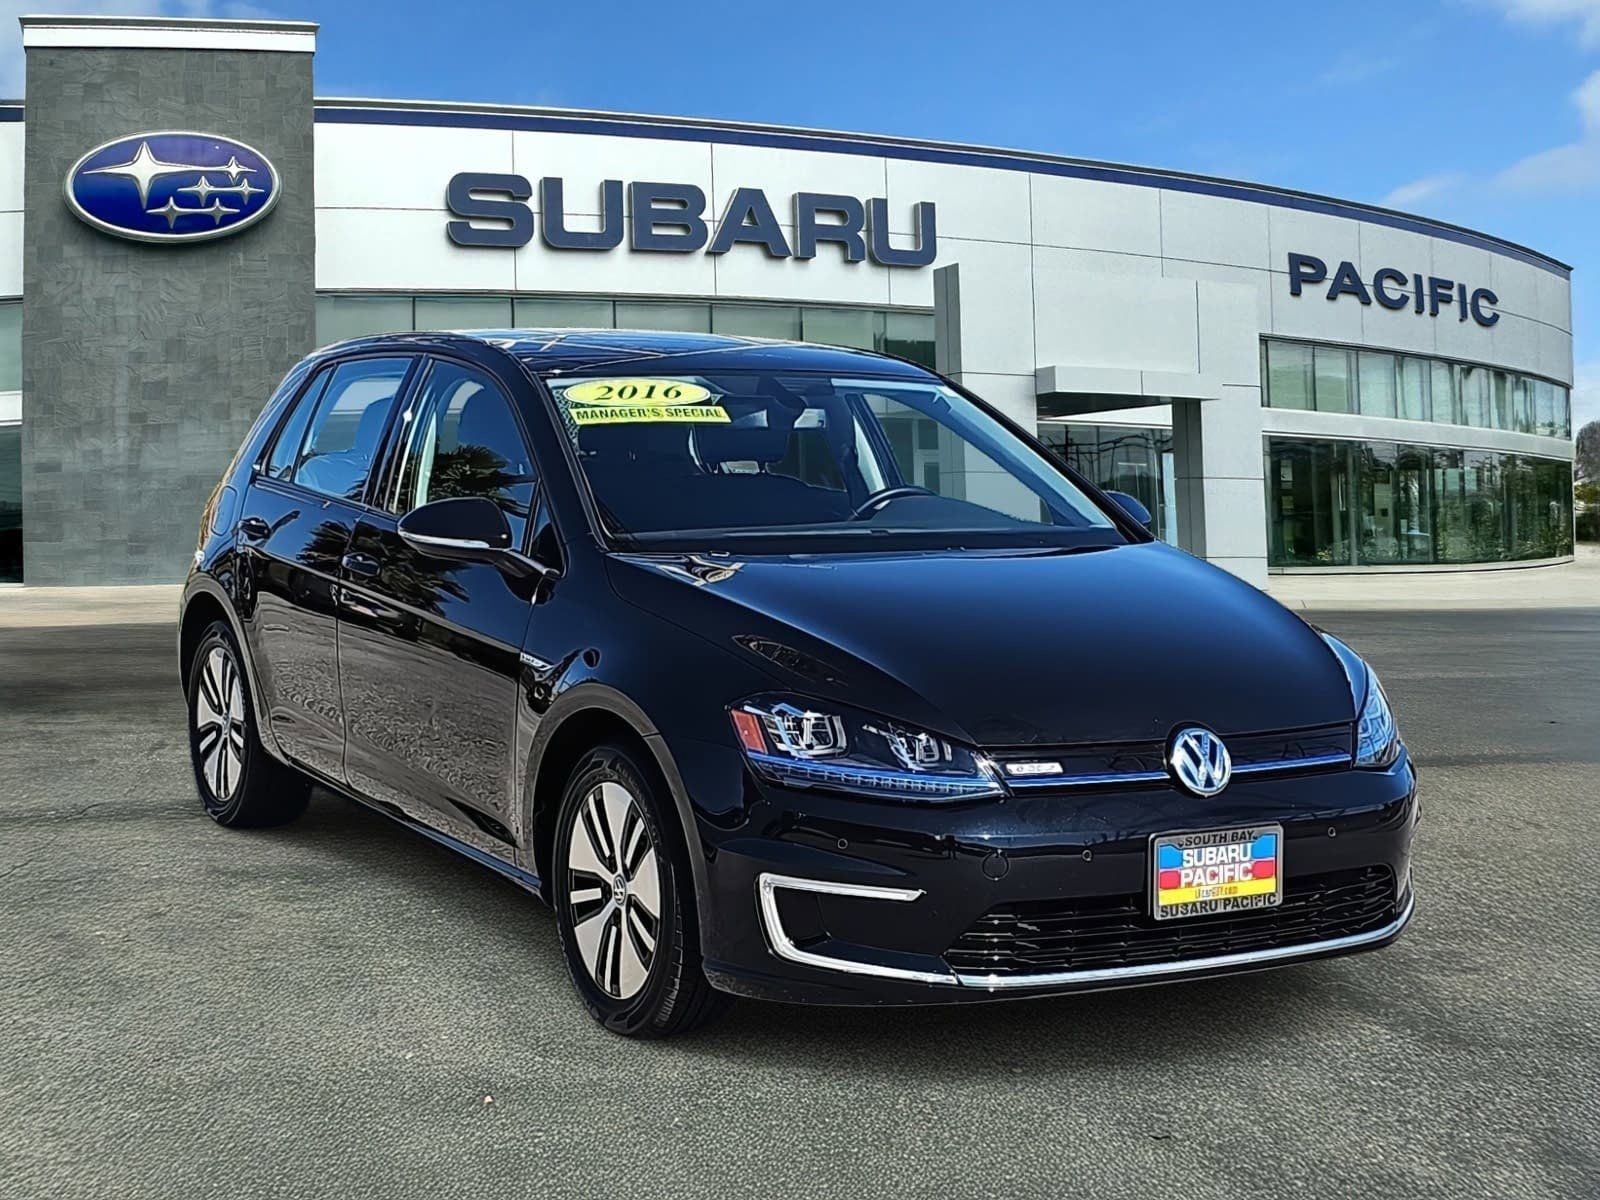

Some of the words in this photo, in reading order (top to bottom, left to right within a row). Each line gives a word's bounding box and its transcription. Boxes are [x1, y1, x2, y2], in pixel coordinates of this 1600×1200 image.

[446, 171, 937, 268] SUBARU
[1288, 252, 1500, 327] PACIFIC
[594, 384, 682, 401] 2016
[576, 407, 662, 420] MANAGER'S
[666, 407, 722, 419] SPECIAL
[1184, 832, 1228, 847] SOUTH
[1230, 830, 1255, 842] BAY
[1182, 842, 1252, 868] SUBARU
[1180, 862, 1254, 888] PACIFIC
[1223, 894, 1277, 910] PACIFIC
